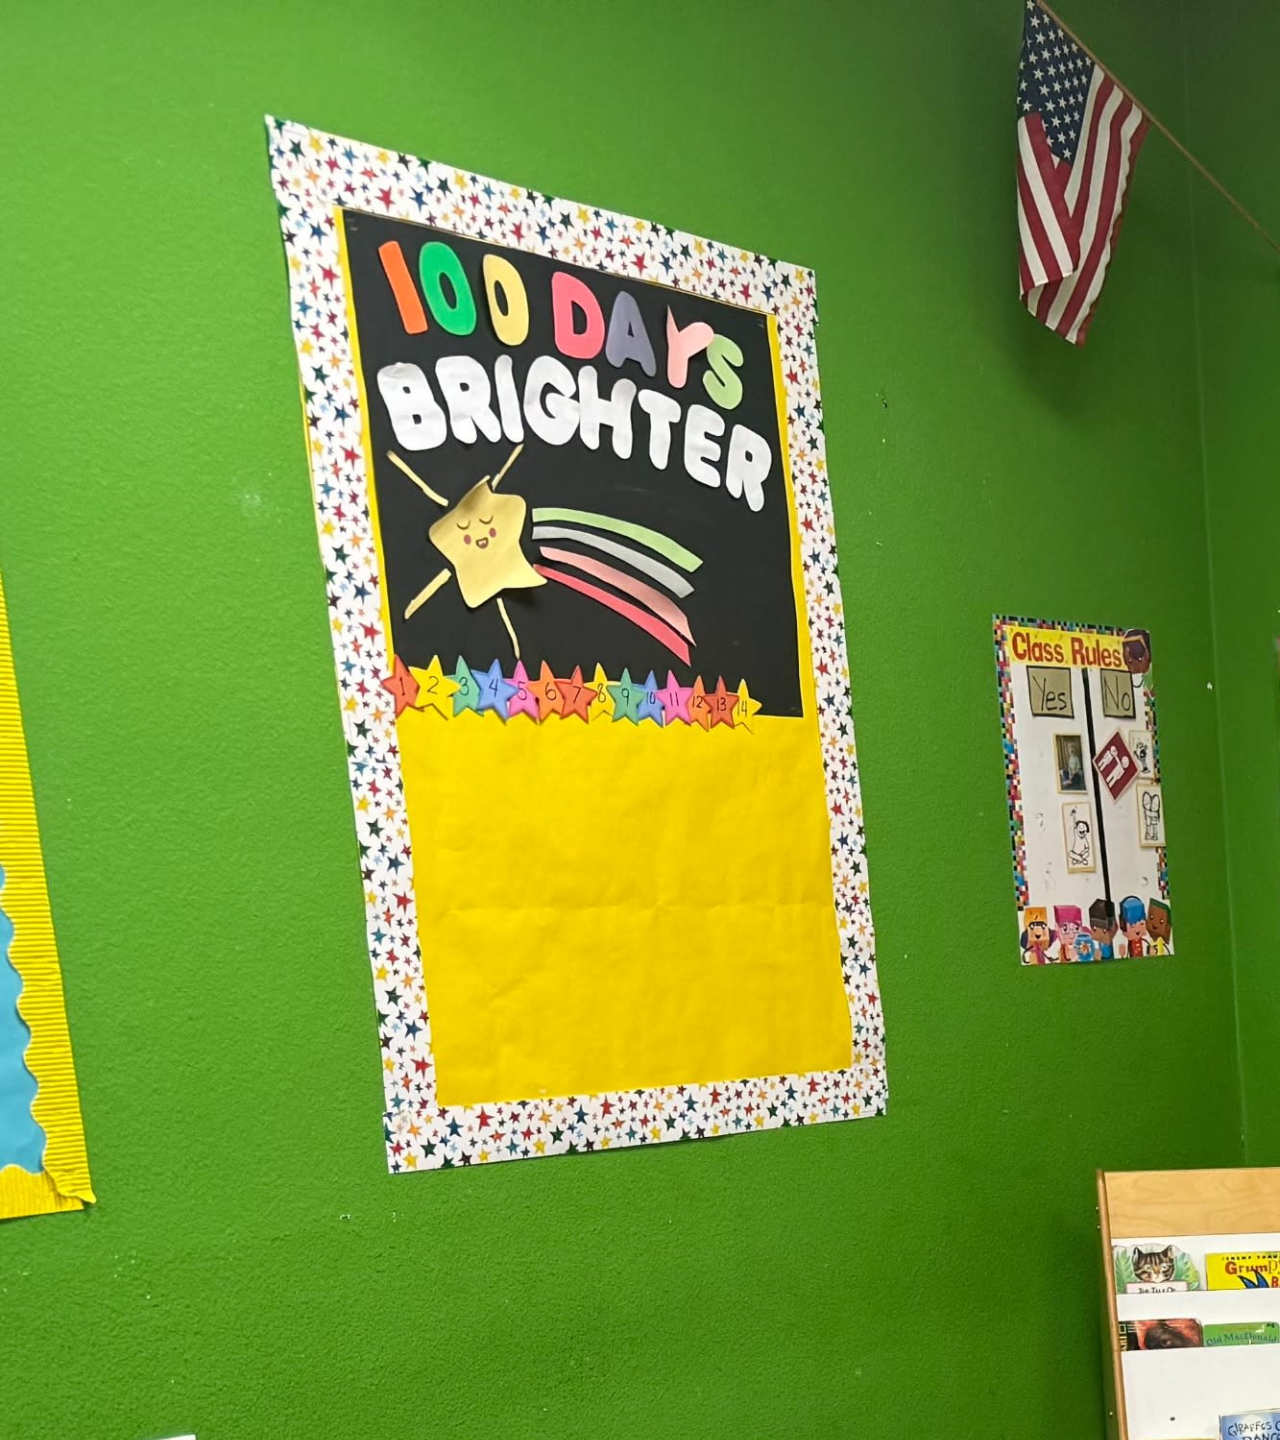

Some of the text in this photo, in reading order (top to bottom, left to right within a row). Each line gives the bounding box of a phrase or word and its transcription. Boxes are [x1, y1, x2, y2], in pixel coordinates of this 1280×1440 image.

[377, 241, 744, 410] 100 DAYS
[377, 354, 772, 511] BRIGHTER
[1011, 632, 1121, 667] Class Rules
[427, 676, 439, 693] 2
[461, 677, 469, 695] 3
[488, 677, 498, 698] 4
[518, 681, 528, 700] 5
[545, 682, 556, 700] 6
[598, 684, 607, 702] 8
[1032, 676, 1068, 711] Yes
[1105, 673, 1131, 710] No
[573, 686, 582, 702] 7
[622, 689, 630, 707] 9
[646, 691, 656, 705] 10
[670, 690, 679, 705] 11
[692, 695, 703, 708] 12
[715, 698, 727, 711] 13
[737, 701, 748, 716] 14
